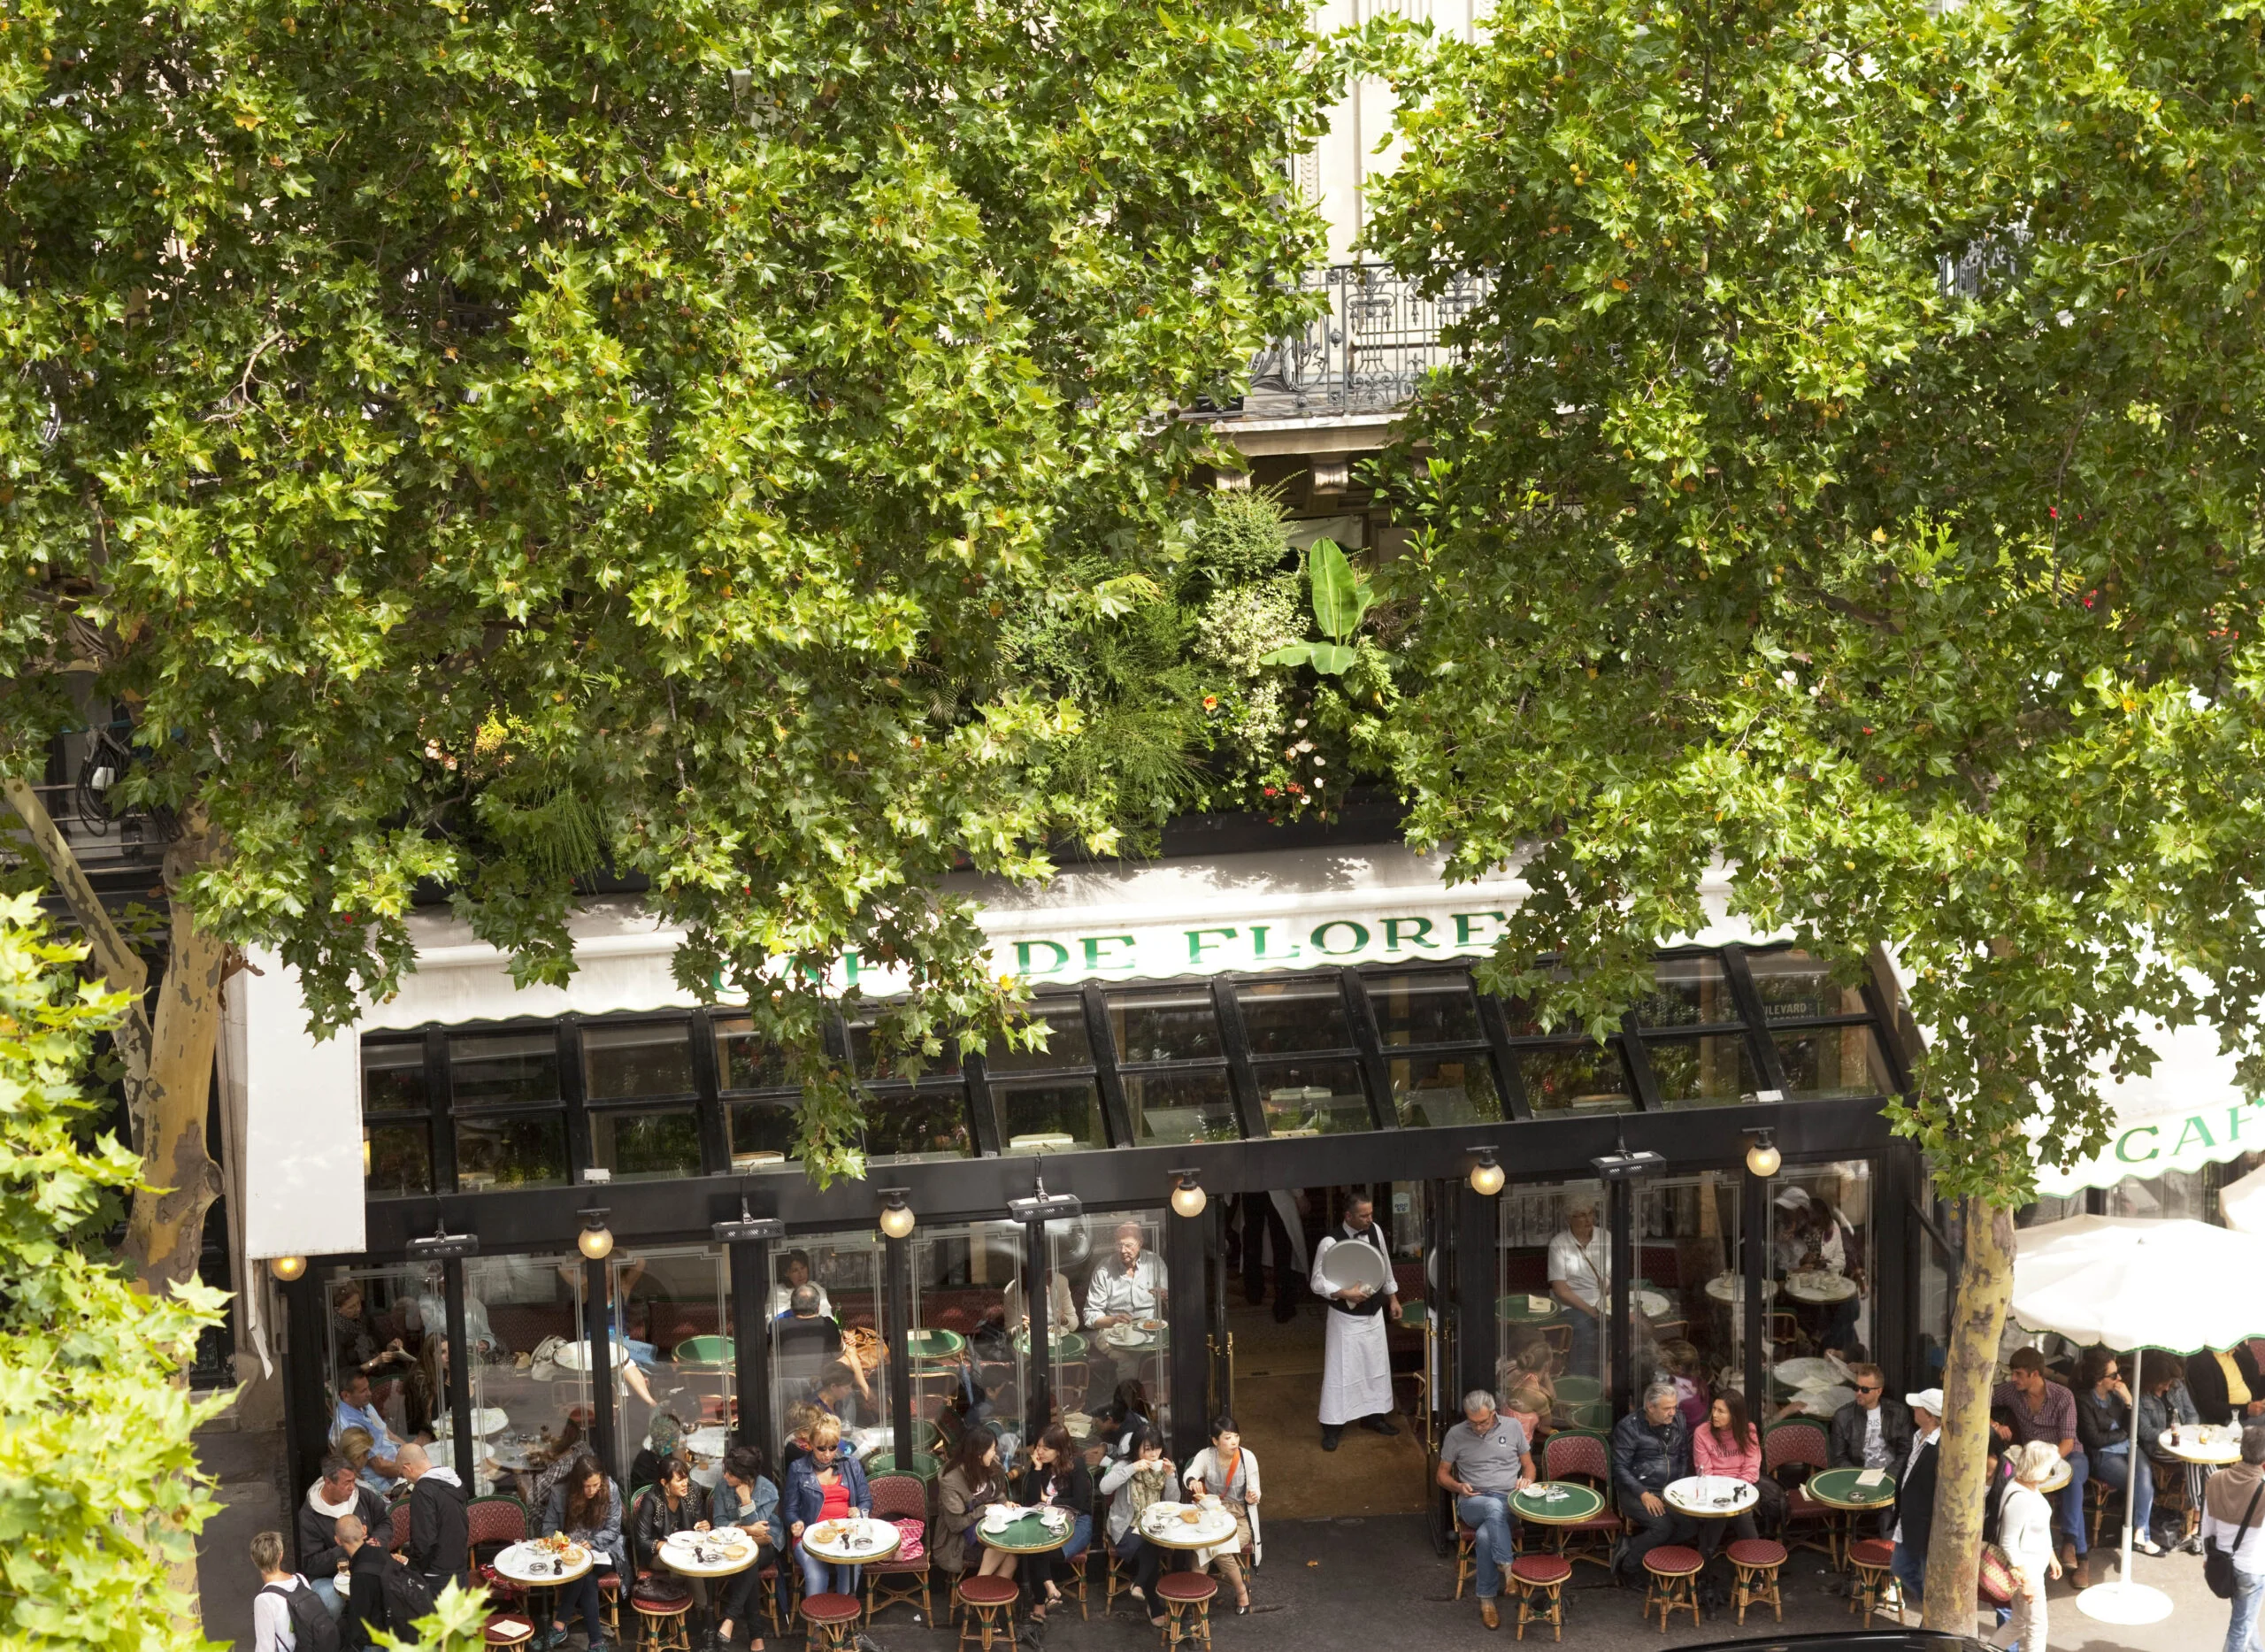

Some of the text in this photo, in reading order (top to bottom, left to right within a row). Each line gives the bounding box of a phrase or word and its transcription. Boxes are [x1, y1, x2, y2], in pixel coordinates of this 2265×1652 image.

[710, 911, 1508, 994] CAF DE FLORE
[1763, 1003, 1807, 1016] ULEVARD
[2115, 1097, 2265, 1164] CAF
